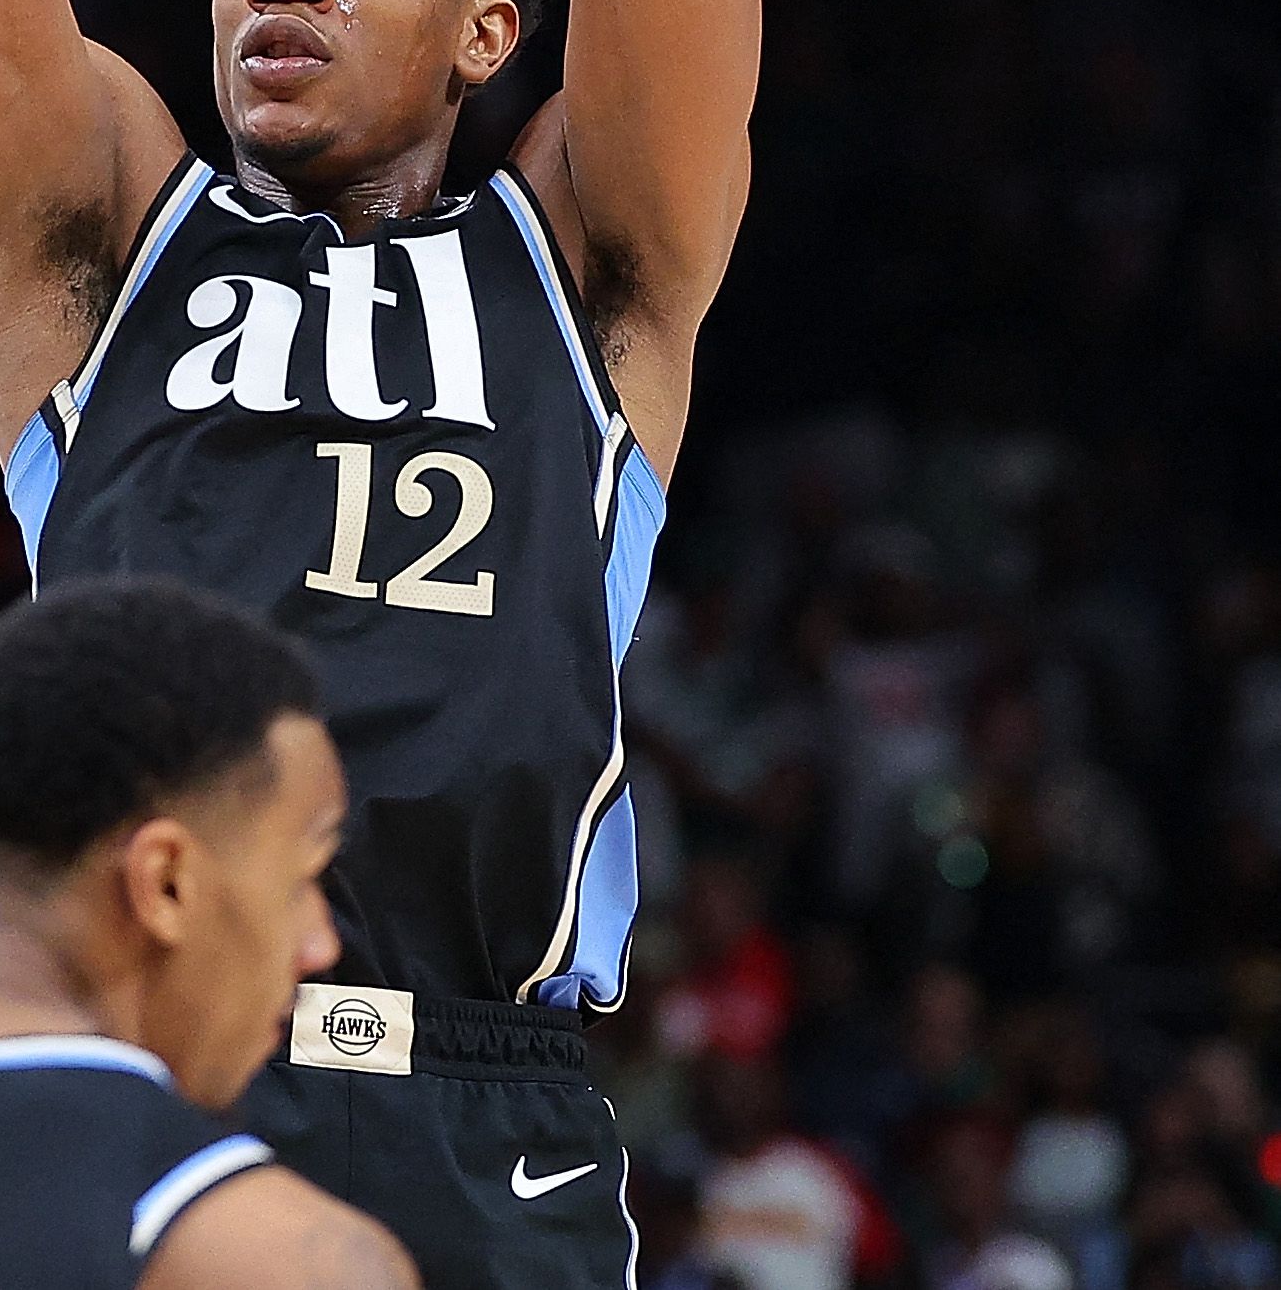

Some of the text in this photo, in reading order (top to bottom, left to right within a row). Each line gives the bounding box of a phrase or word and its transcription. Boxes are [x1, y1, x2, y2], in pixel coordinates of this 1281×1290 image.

[165, 229, 496, 431] atl
[305, 442, 495, 616] 12
[321, 1014, 387, 1040] HAWKS
